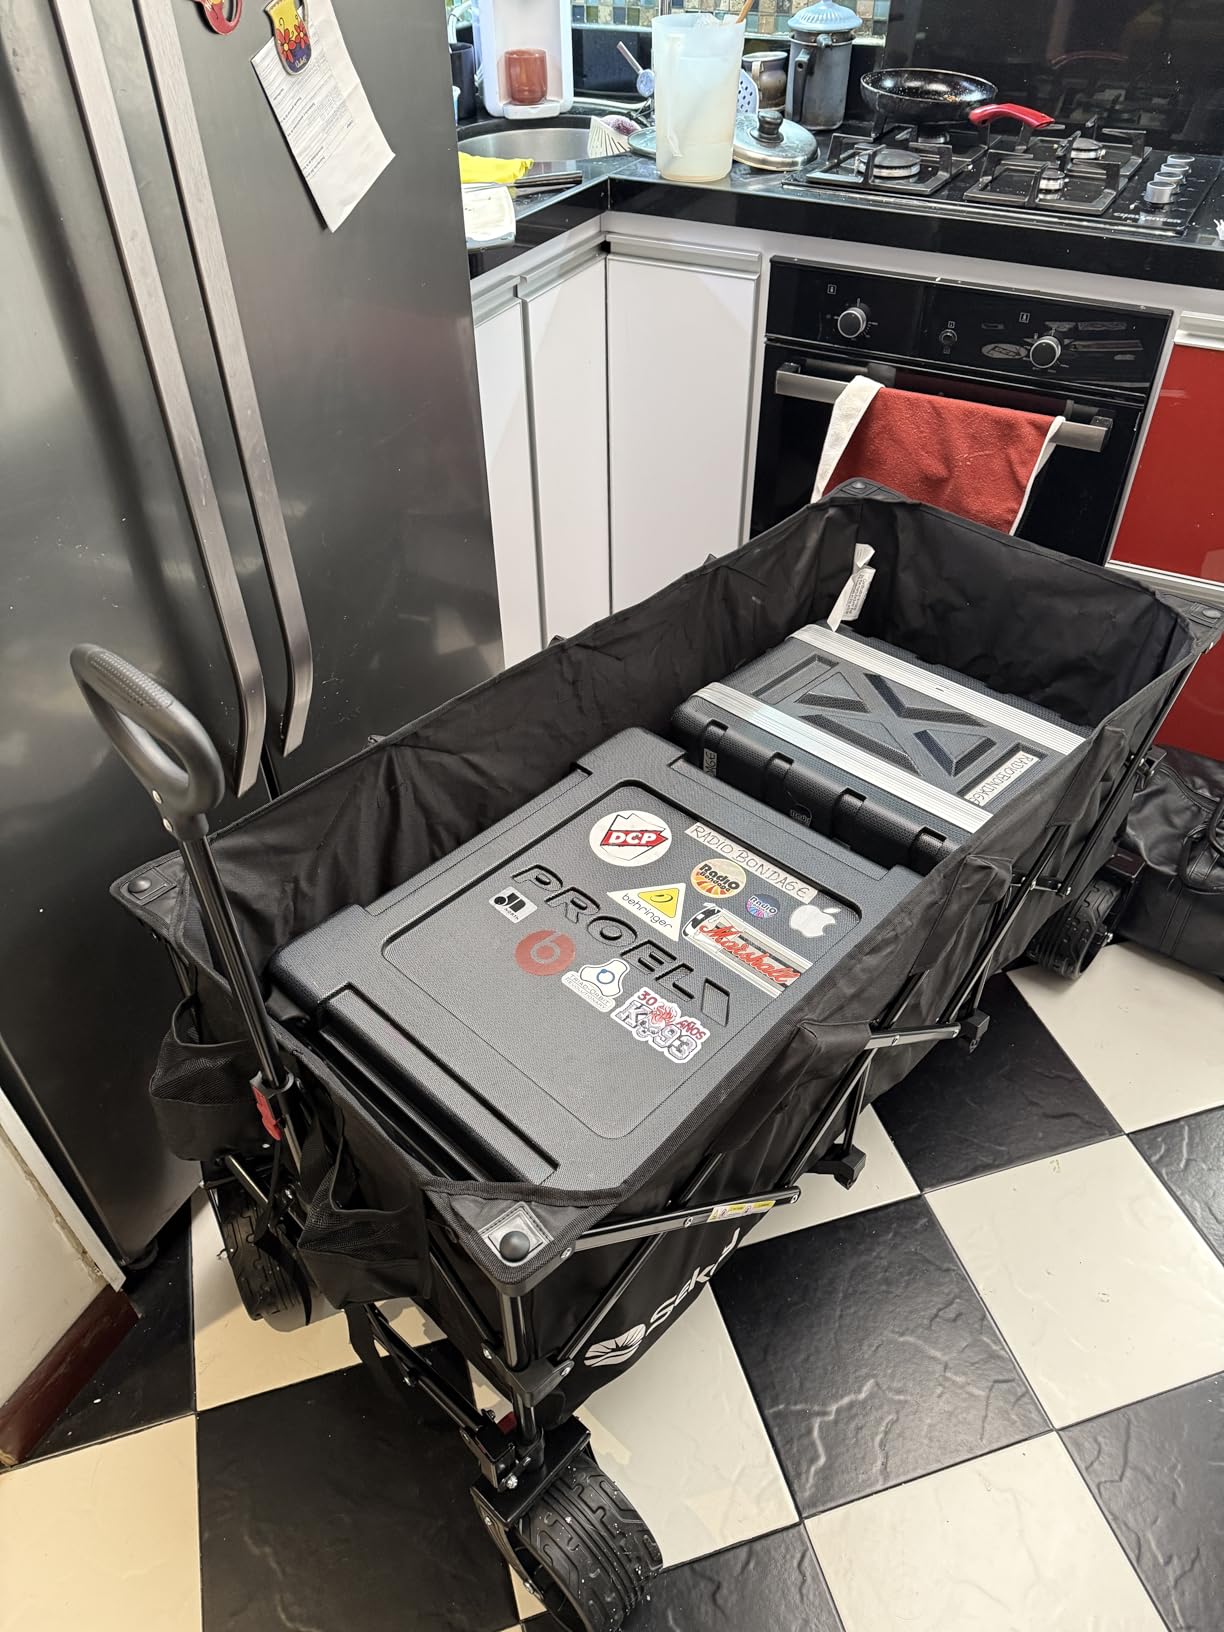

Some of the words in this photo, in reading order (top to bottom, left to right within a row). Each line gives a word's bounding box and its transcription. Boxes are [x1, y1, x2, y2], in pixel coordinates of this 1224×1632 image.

[608, 831, 657, 844] DCP
[622, 892, 672, 929] behringer
[512, 864, 694, 1002] PROEL
[697, 925, 801, 983] Marshall
[638, 990, 658, 1006] 30
